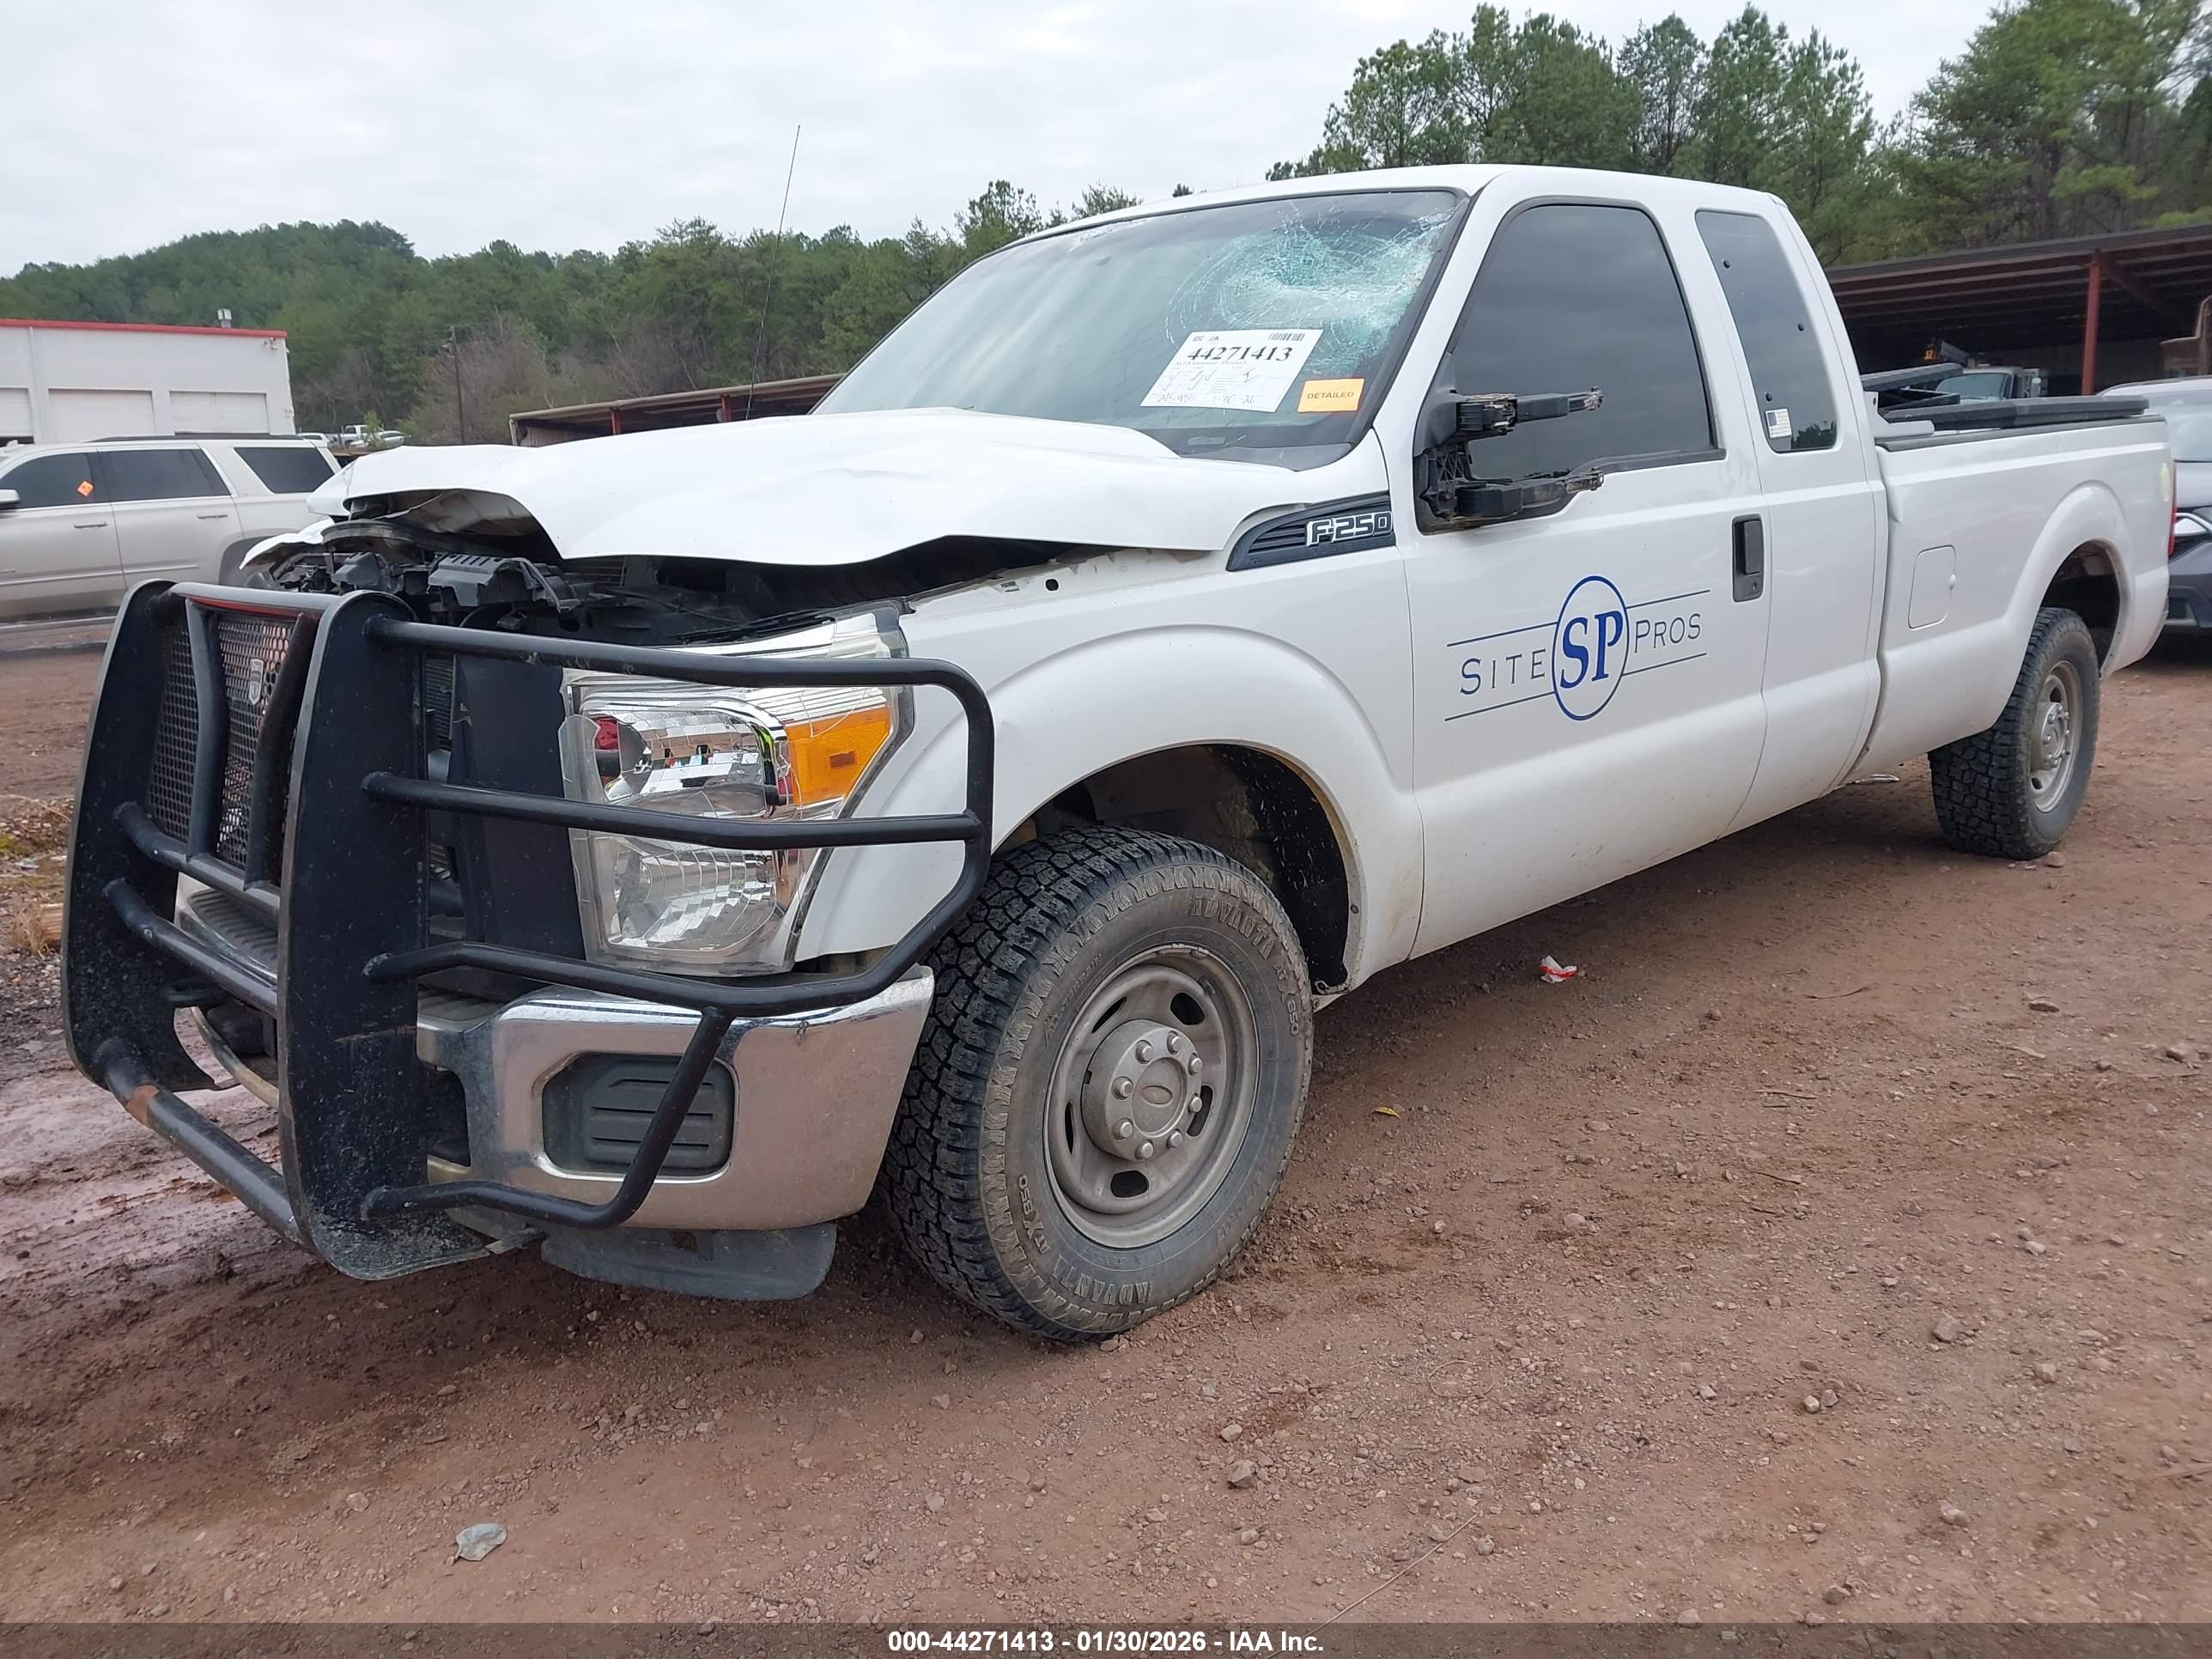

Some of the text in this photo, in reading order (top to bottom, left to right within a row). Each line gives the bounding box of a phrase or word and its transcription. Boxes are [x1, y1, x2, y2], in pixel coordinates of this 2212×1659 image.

[1188, 346, 1293, 362] 44271413
[1306, 391, 1354, 399] DETAILED
[1306, 511, 1392, 547] F-250
[1460, 610, 1701, 695] SITE SP PROS
[1188, 896, 1277, 960] ADVANTA
[1050, 1253, 1152, 1305] ADVANTA
